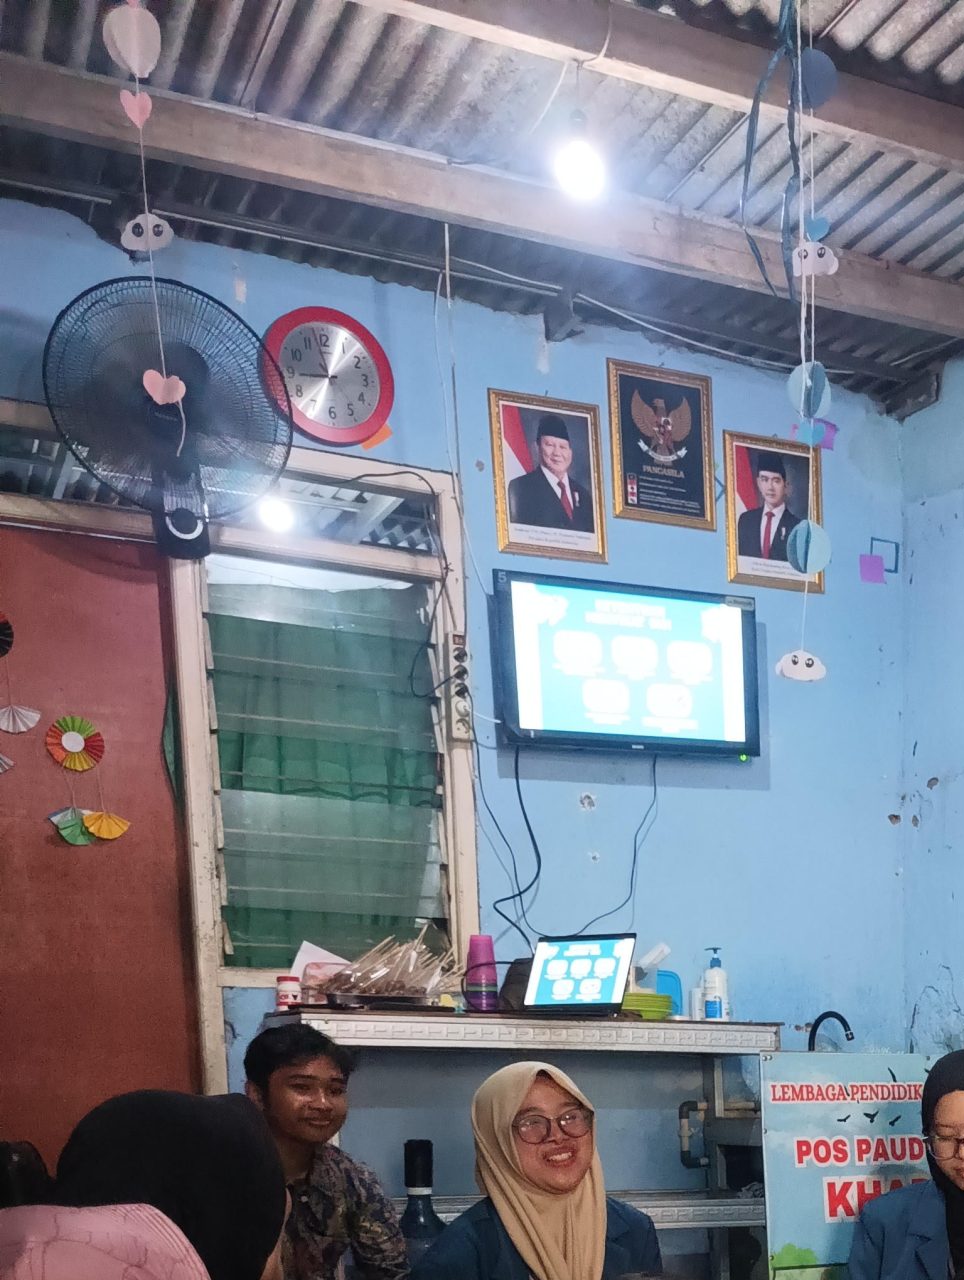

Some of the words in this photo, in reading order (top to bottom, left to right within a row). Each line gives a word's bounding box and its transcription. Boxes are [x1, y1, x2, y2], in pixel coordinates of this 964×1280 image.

[320, 334, 330, 347] 12
[291, 350, 302, 362] 10
[354, 356, 361, 369] 2
[287, 366, 295, 379] 9
[361, 374, 369, 388] 3
[296, 385, 303, 398] 8
[358, 392, 365, 404] 4
[329, 406, 337, 420] 6
[347, 404, 354, 416] 5
[642, 465, 685, 478] PANCASILA
[770, 1084, 847, 1101] LEMBAGA
[796, 1139, 849, 1164] POS
[856, 1137, 924, 1162] PAUD
